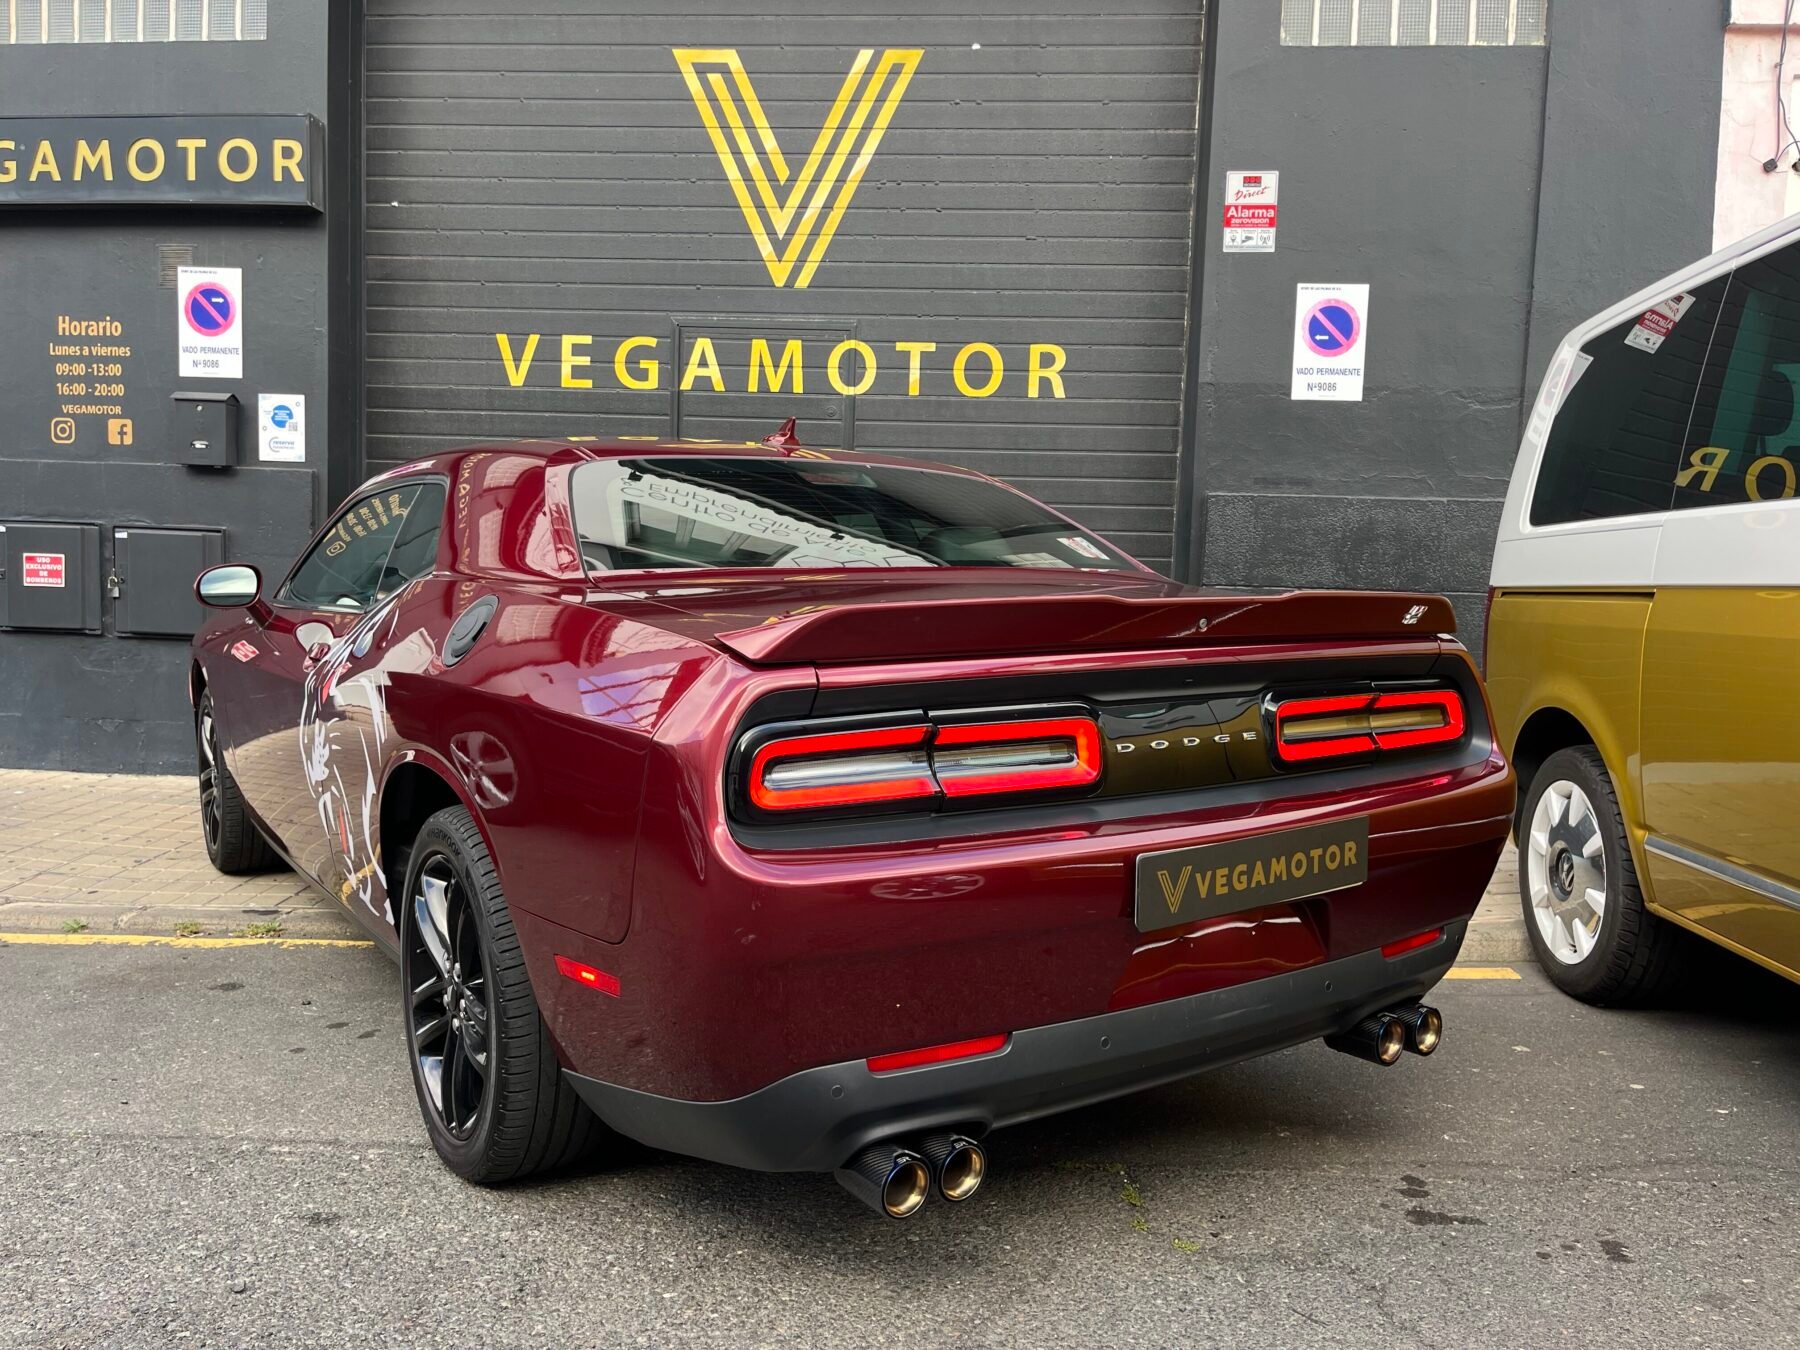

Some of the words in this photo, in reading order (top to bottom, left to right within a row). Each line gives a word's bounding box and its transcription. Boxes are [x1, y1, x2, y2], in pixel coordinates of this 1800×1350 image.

[1227, 206, 1274, 218] Alarma
[57, 316, 122, 336] Horario
[49, 342, 80, 356] Lunes
[82, 345, 89, 356] a
[91, 344, 131, 356] viernes
[182, 345, 198, 354] VADO
[199, 346, 240, 356] PERMANENTE
[55, 363, 86, 376] 09:00
[495, 332, 1068, 399] VEGAMOTOR
[1296, 367, 1314, 376] VADO
[1316, 368, 1361, 377] PERMANENTE
[56, 383, 86, 395] 16:00
[94, 383, 125, 396] 20:00
[62, 404, 122, 415] VEGAMOTOR
[1116, 730, 1259, 754] DODGE
[1194, 840, 1358, 899] VEGAMOTOR
